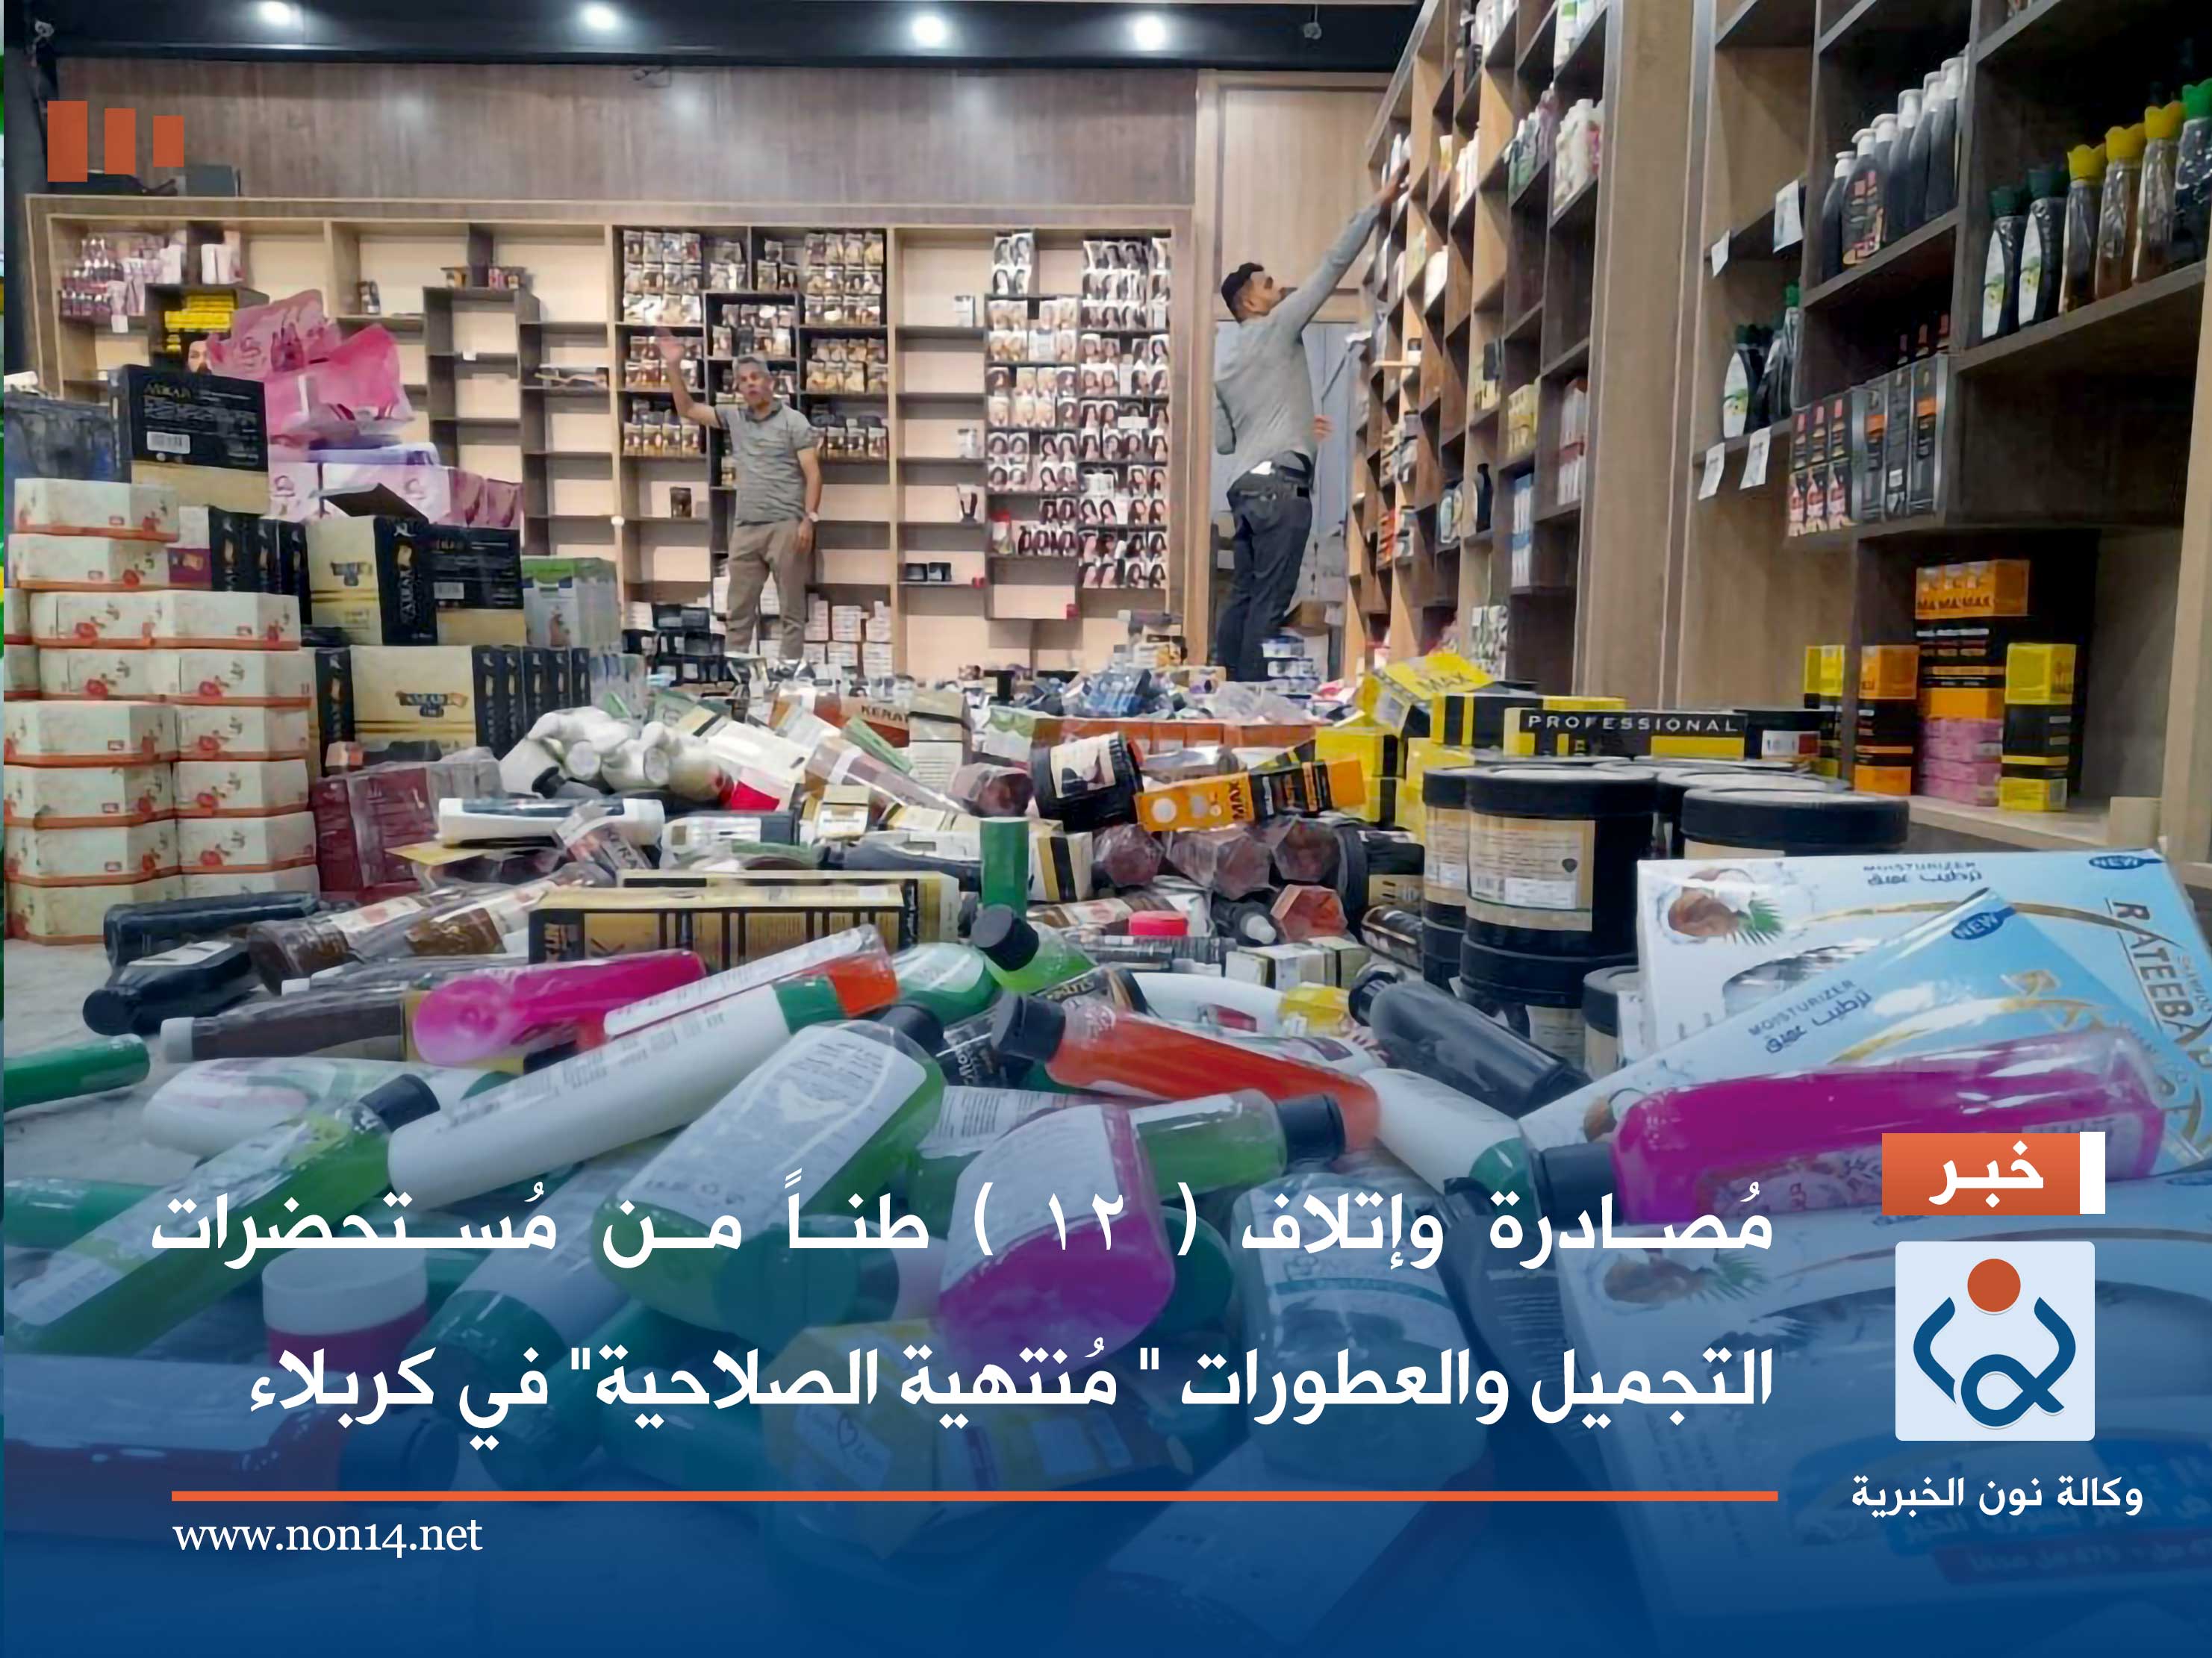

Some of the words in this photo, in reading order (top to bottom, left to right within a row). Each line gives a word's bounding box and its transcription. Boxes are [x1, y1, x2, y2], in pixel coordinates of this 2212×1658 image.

[1527, 715, 1738, 732] PROFESSIONAL
[1955, 911, 1998, 939] NEW
[1748, 979, 1856, 1037] MOISTURIZER
[1811, 988, 1872, 1027] ترطيب
[1766, 1025, 1807, 1053] عميق
